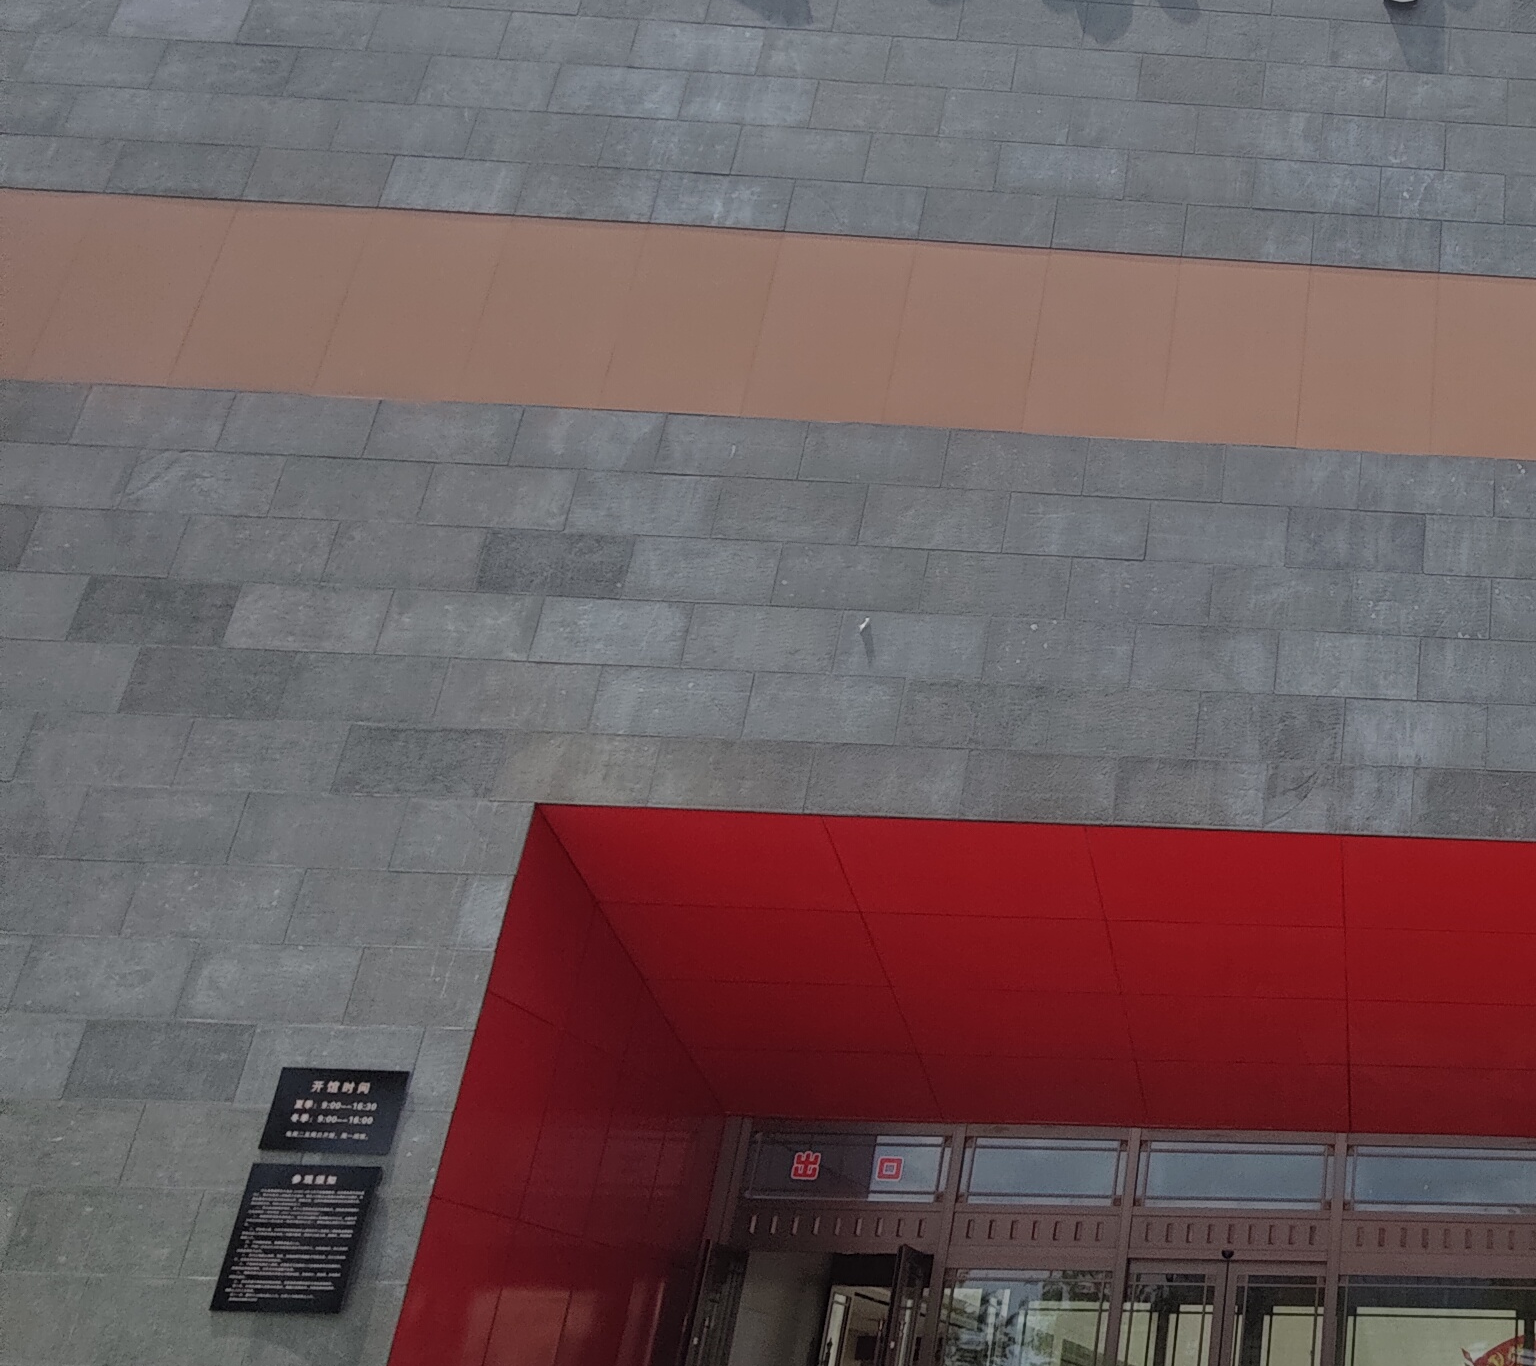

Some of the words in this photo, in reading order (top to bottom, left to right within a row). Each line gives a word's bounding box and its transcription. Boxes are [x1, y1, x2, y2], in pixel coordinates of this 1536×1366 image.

[310, 1080, 371, 1094] 开馆时间
[790, 1150, 905, 1182] 出口
